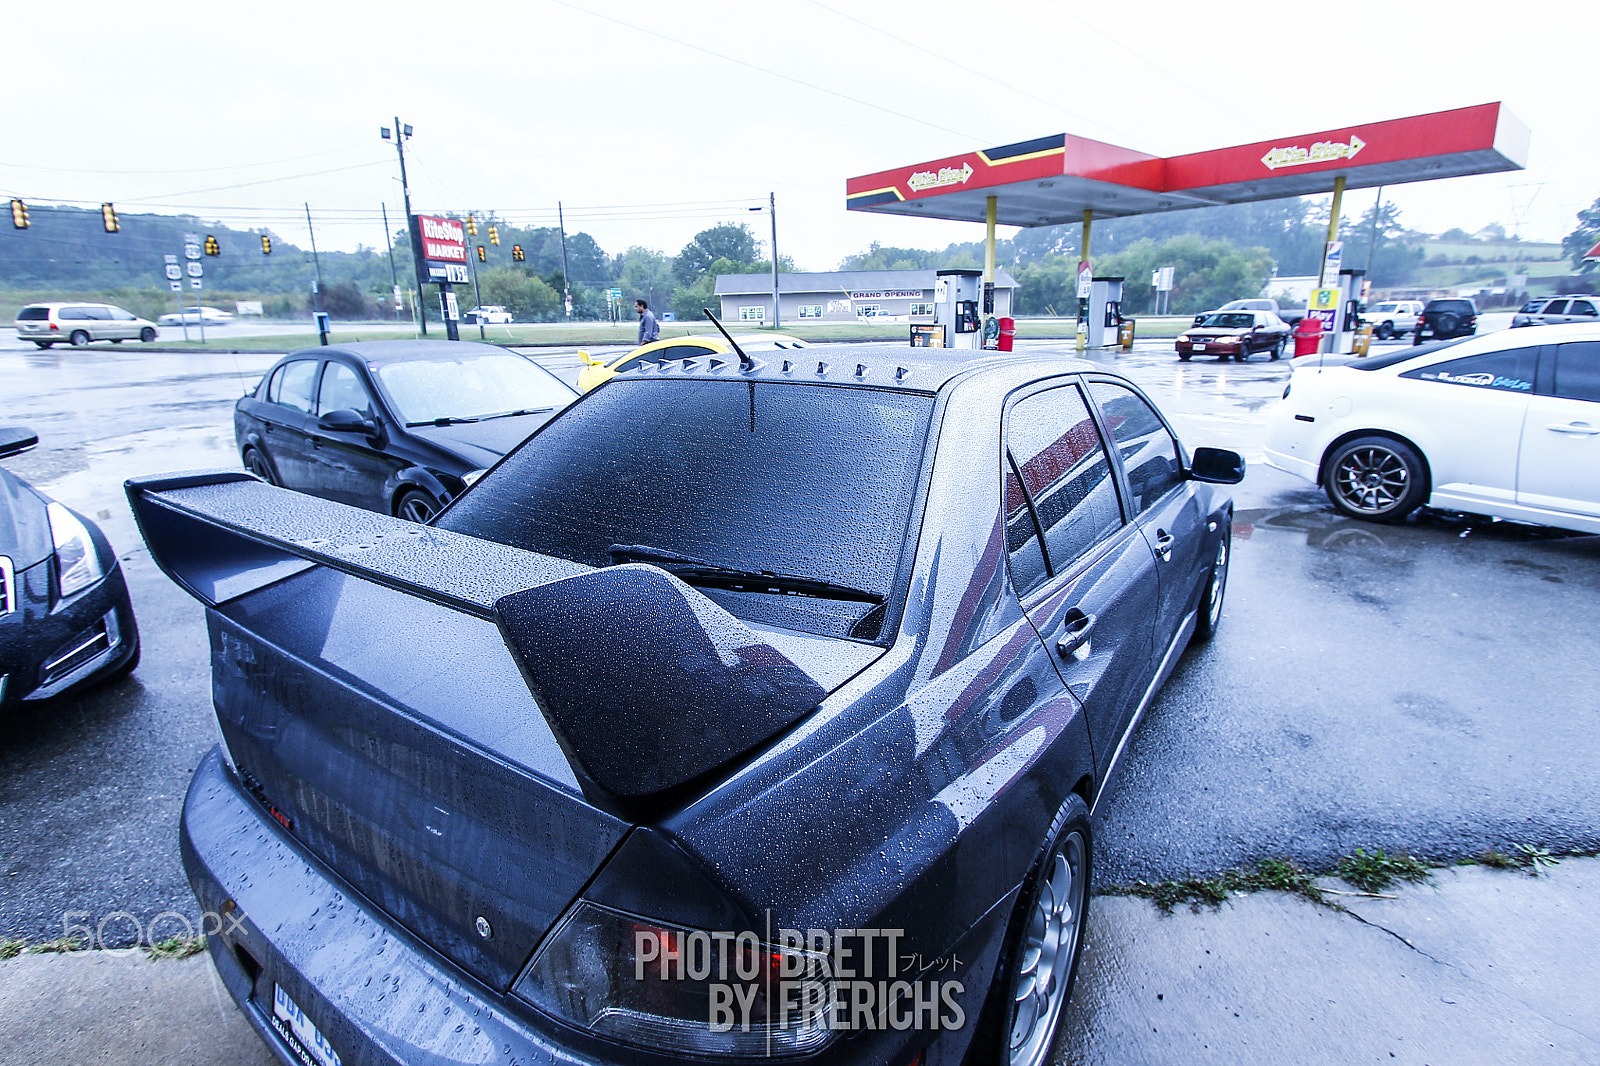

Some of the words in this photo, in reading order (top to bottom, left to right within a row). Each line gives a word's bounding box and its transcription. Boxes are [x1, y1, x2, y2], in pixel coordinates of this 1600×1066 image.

[422, 218, 464, 245] RiteStop
[427, 243, 465, 259] MARKET
[1309, 310, 1334, 322] Play
